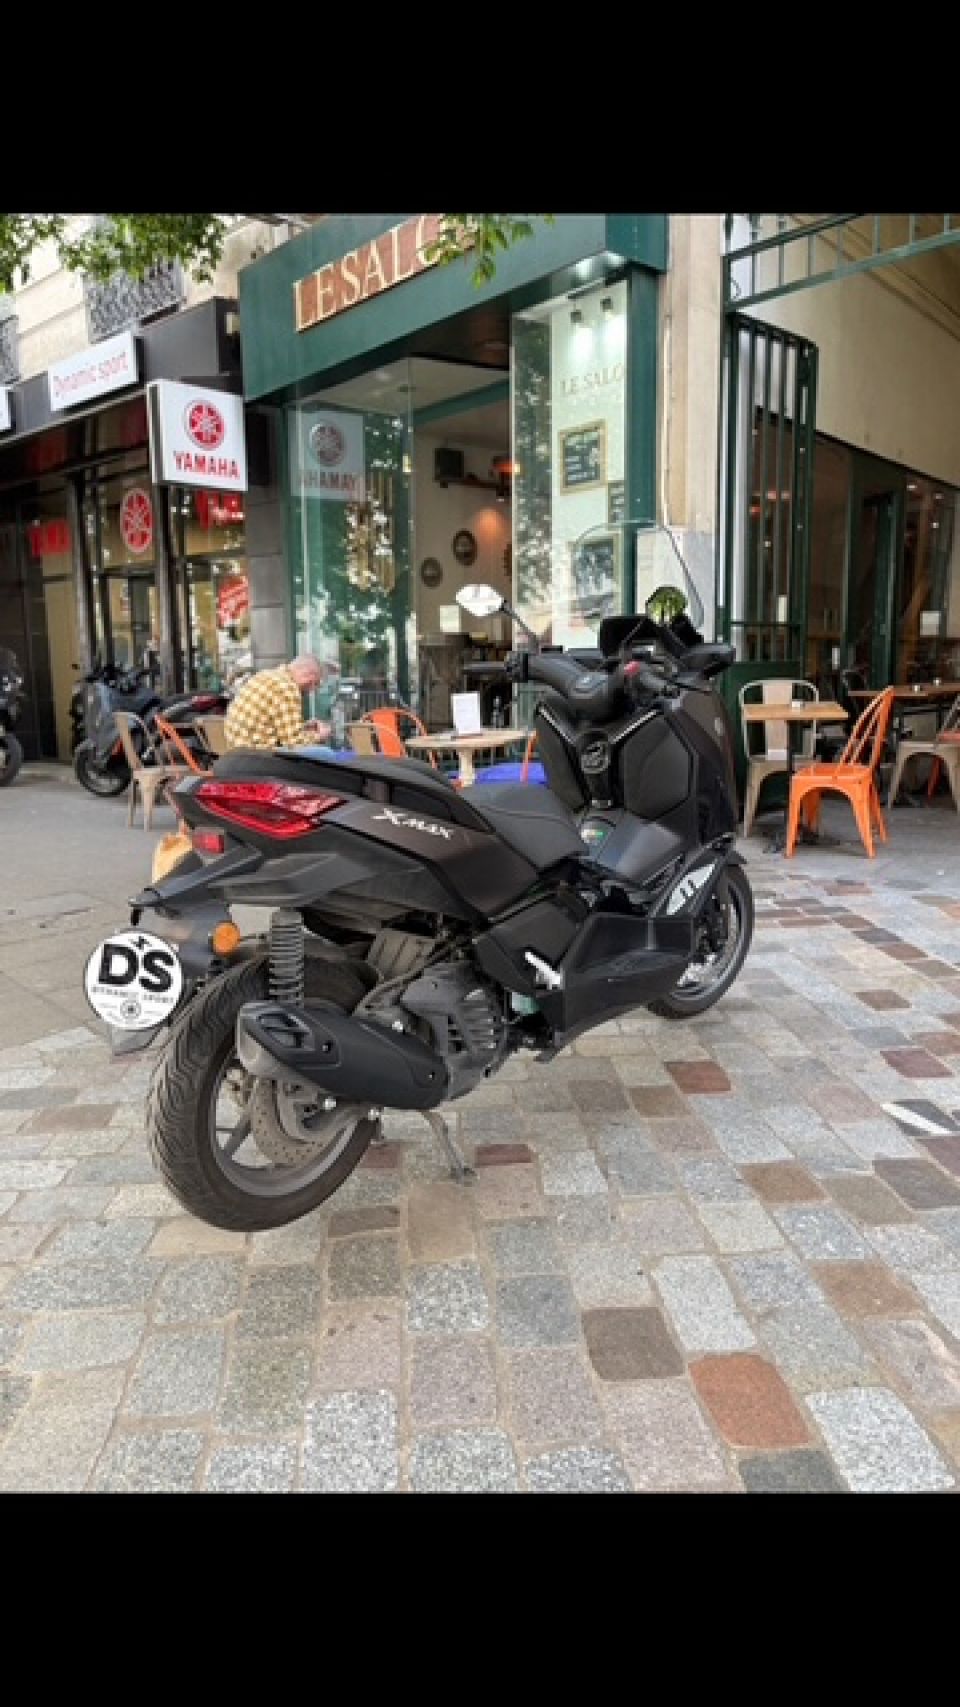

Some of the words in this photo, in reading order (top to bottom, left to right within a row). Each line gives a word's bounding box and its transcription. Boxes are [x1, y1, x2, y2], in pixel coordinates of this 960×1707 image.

[53, 366, 97, 399] Dynamic
[98, 351, 128, 381] sport
[173, 450, 241, 481] YAMAHA
